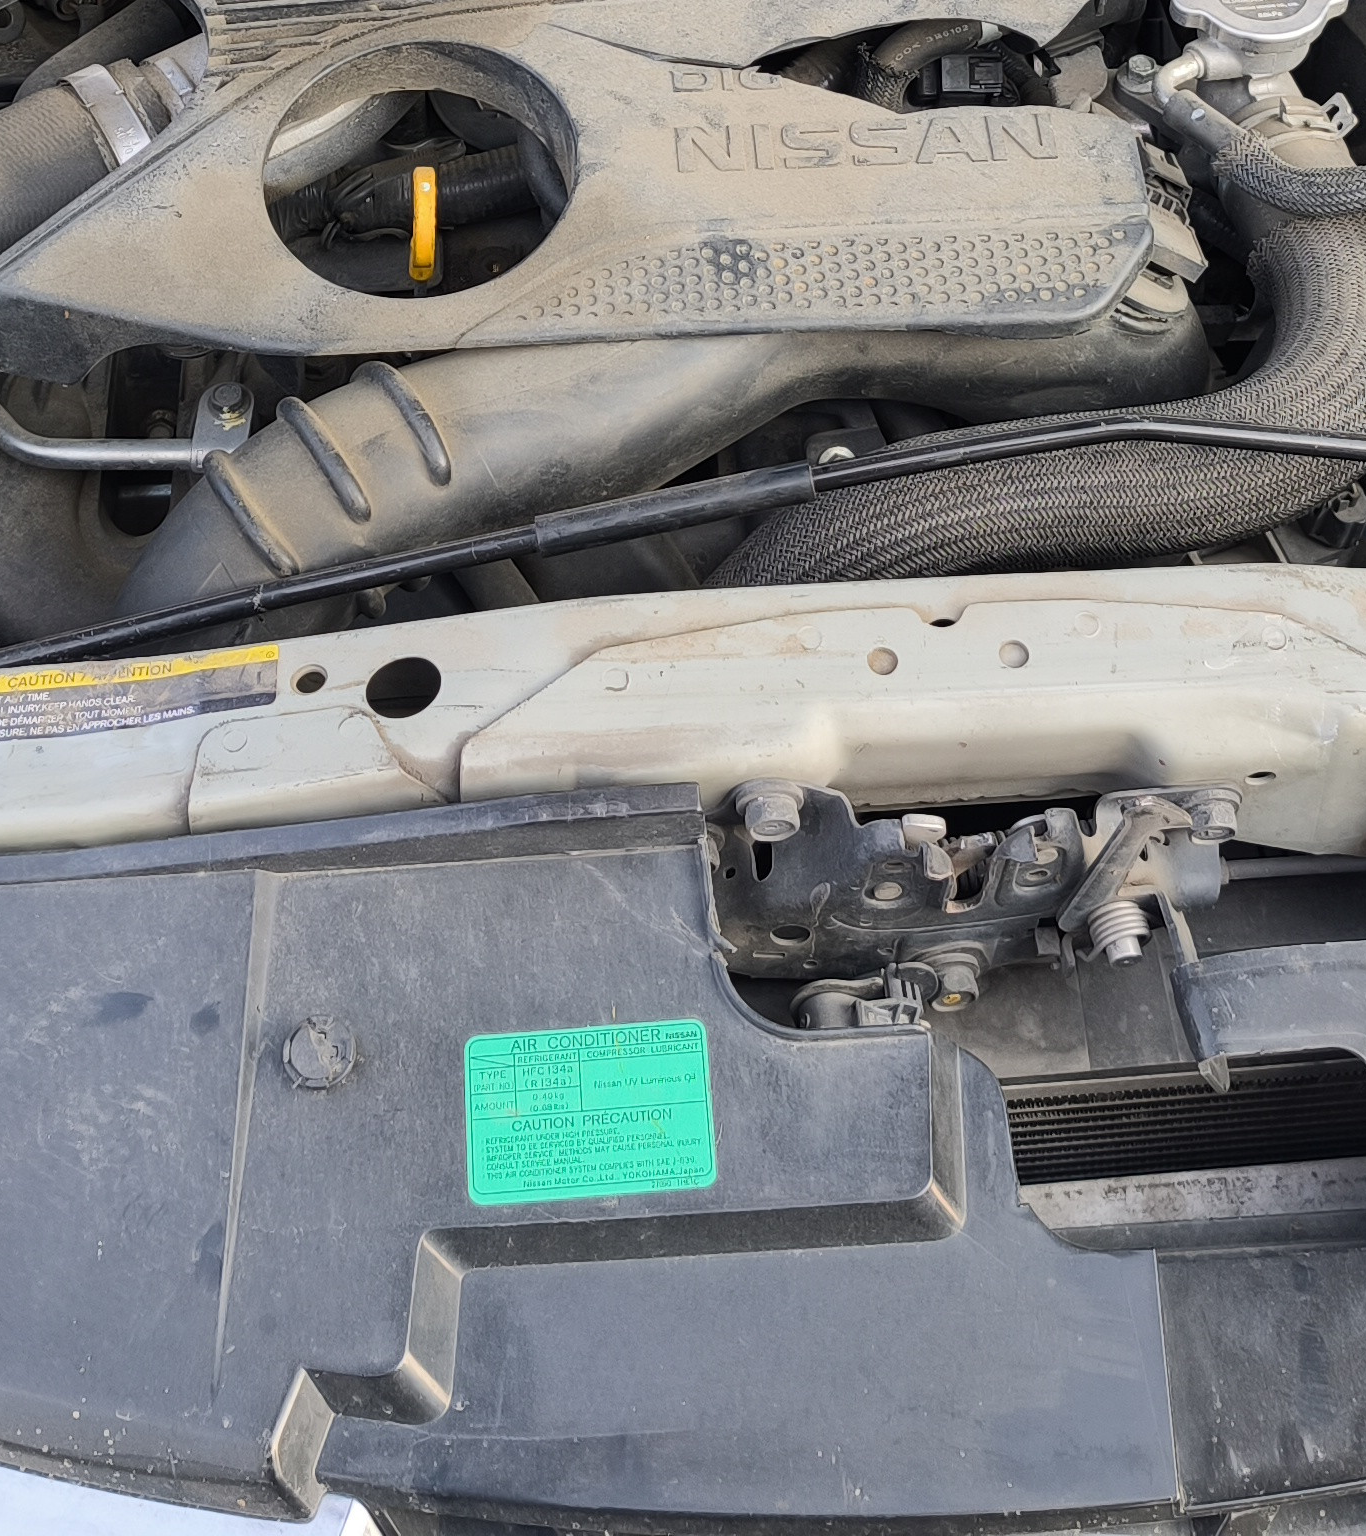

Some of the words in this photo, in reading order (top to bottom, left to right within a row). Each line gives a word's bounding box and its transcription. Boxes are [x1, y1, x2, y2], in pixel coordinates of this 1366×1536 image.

[673, 113, 1058, 172] NISSAN
[8, 672, 75, 688] CAUTION
[69, 698, 102, 708] HANDS
[74, 709, 100, 719] TOUT
[30, 726, 43, 735] NE
[45, 724, 64, 734] PAS
[82, 716, 141, 730] APPROCHER
[143, 712, 161, 722] LES
[511, 1039, 537, 1053] AIR
[547, 1028, 661, 1050] CONDITIONER
[665, 1030, 698, 1040] NISSAN
[586, 1046, 646, 1058] COMPRESSOR
[651, 1042, 699, 1054] LUBRICANT
[517, 1052, 577, 1064] REFRIGERANT
[479, 1069, 507, 1080] TYPE
[593, 1078, 623, 1089] Nissan
[625, 1077, 640, 1087] UV
[474, 1100, 515, 1111] AMOUNT
[511, 1116, 575, 1132] CAUTION
[583, 1108, 672, 1126] PRÉCAUTION
[517, 1143, 526, 1151] TO
[577, 1138, 586, 1146] BY
[523, 1178, 553, 1188] Nissan
[555, 1176, 580, 1187] Motor
